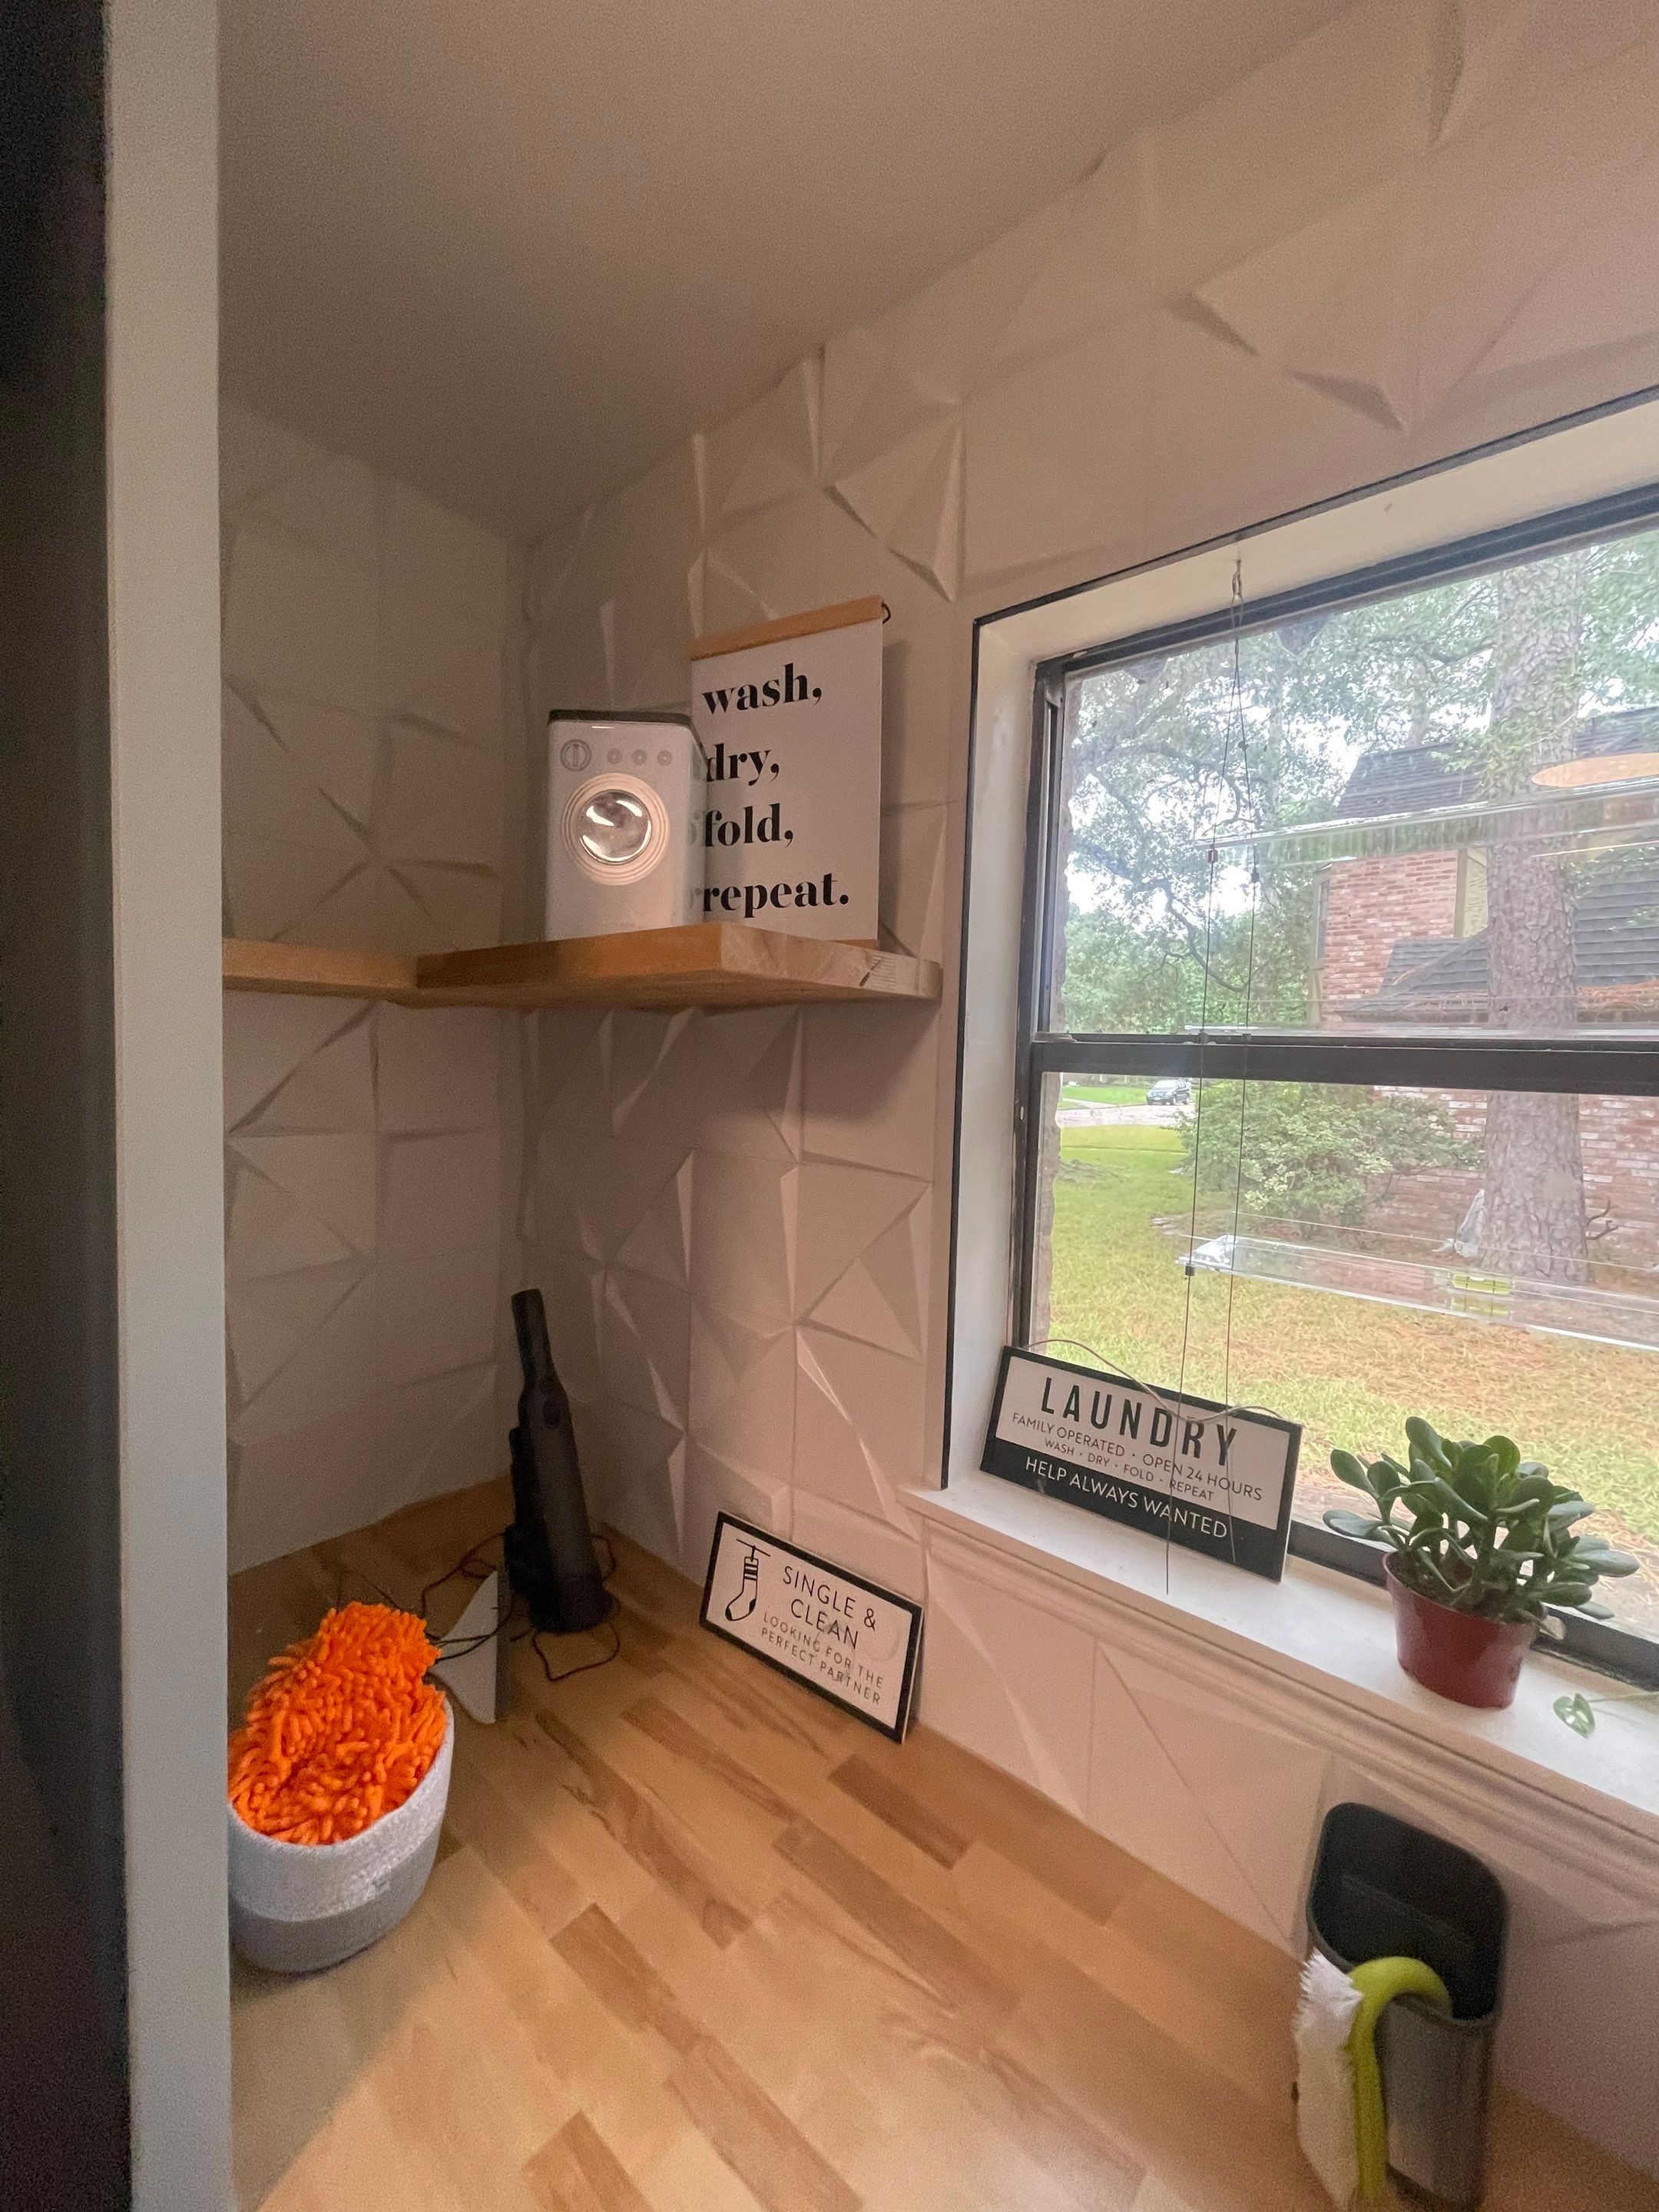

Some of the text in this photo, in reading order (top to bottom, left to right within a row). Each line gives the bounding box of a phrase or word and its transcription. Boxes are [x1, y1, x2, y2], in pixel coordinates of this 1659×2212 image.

[701, 663, 822, 714] wash,
[706, 743, 780, 786] dry,
[704, 803, 794, 848] fold,
[703, 873, 849, 918] repeat.
[1041, 1376, 1237, 1466] LAUNDRY
[1012, 1412, 1263, 1501] FAMILY OPERATED OPEN 24 HOURS
[1045, 1438, 1214, 1502] WASH DRY FOLD REPEAT
[1025, 1456, 1228, 1538] HELP ALWAYS WANTED
[782, 1565, 876, 1631] SINGLE &
[790, 1598, 859, 1650] CLEAN
[761, 1627, 881, 1704] PERFECT PARTNER
[763, 1611, 883, 1688] LOOKING FOR THE
